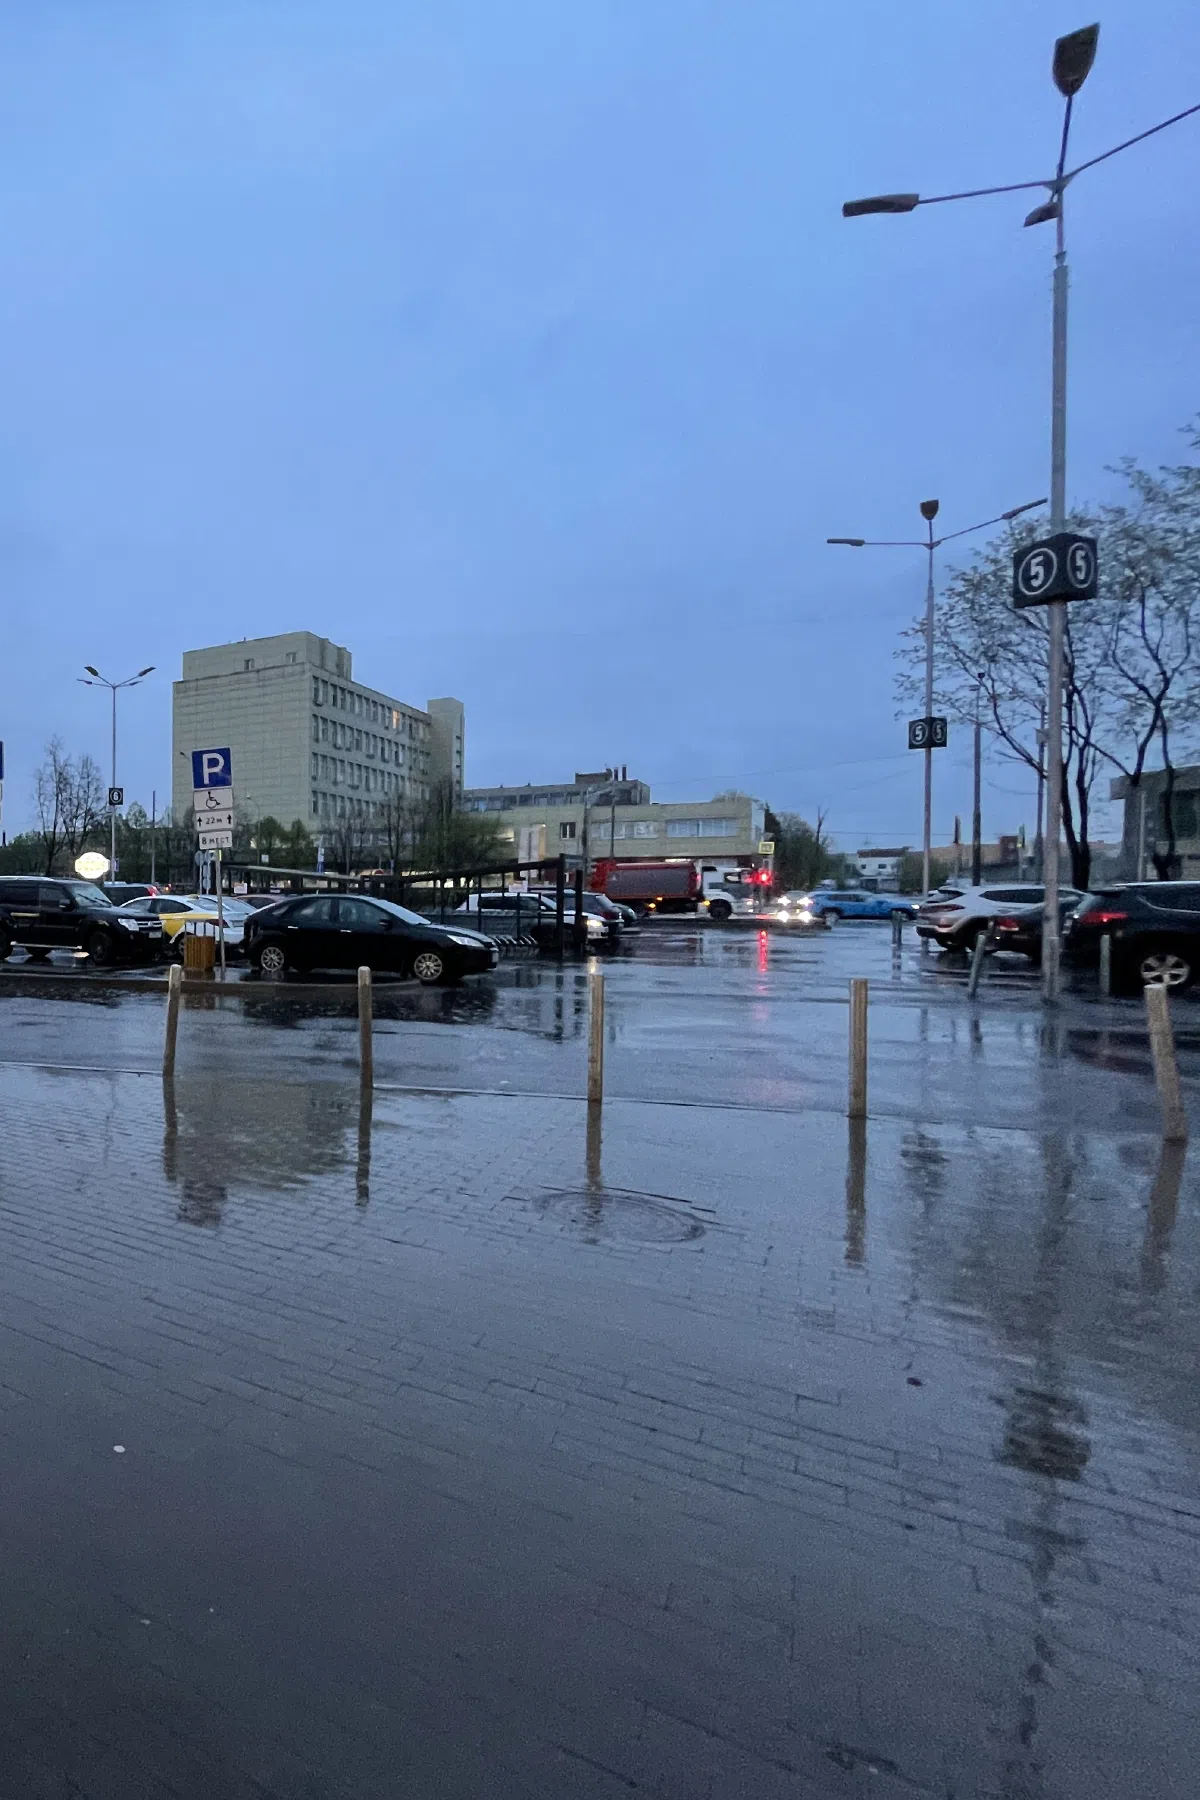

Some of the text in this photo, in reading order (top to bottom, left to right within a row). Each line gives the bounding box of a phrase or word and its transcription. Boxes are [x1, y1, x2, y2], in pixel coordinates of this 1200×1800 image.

[1030, 555, 1044, 587] 5
[1075, 549, 1087, 580] 5
[915, 725, 923, 741] 5
[936, 724, 942, 739] 5
[202, 752, 225, 785] P
[201, 836, 207, 845] 8
